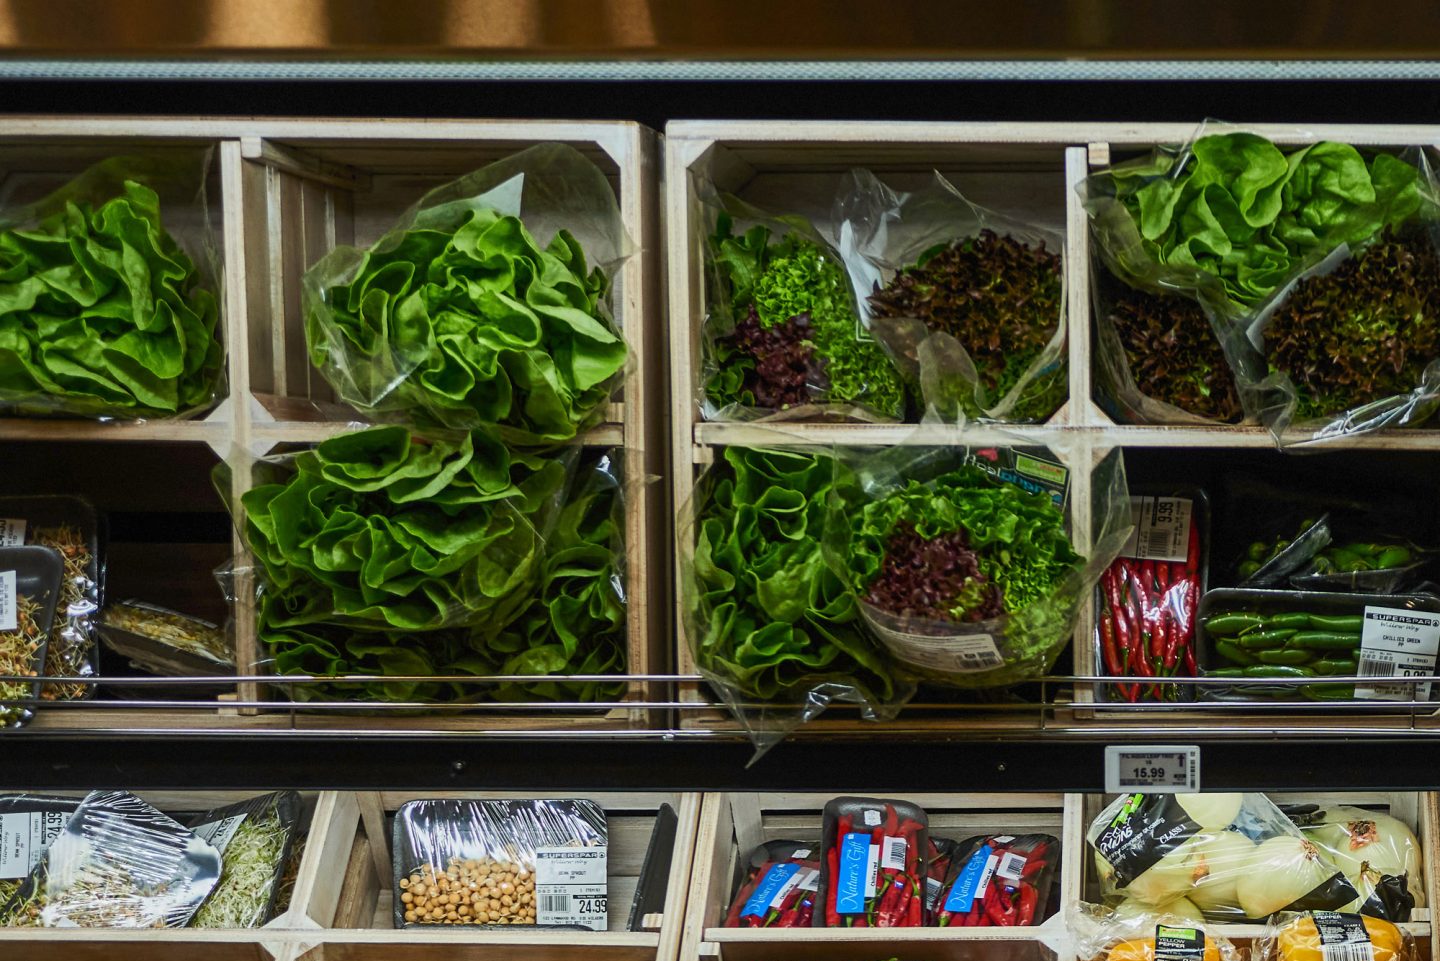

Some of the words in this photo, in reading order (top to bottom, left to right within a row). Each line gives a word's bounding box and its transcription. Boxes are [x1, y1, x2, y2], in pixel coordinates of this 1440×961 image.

[1158, 502, 1174, 523] 9.99
[1372, 614, 1431, 625] SUPERSPAR
[1133, 768, 1165, 778] 15.99
[1159, 827, 1180, 844] CLASS
[846, 841, 866, 862] Gift
[841, 863, 860, 910] Nature's
[950, 871, 976, 909] Nature's
[580, 900, 608, 914] 24.99
